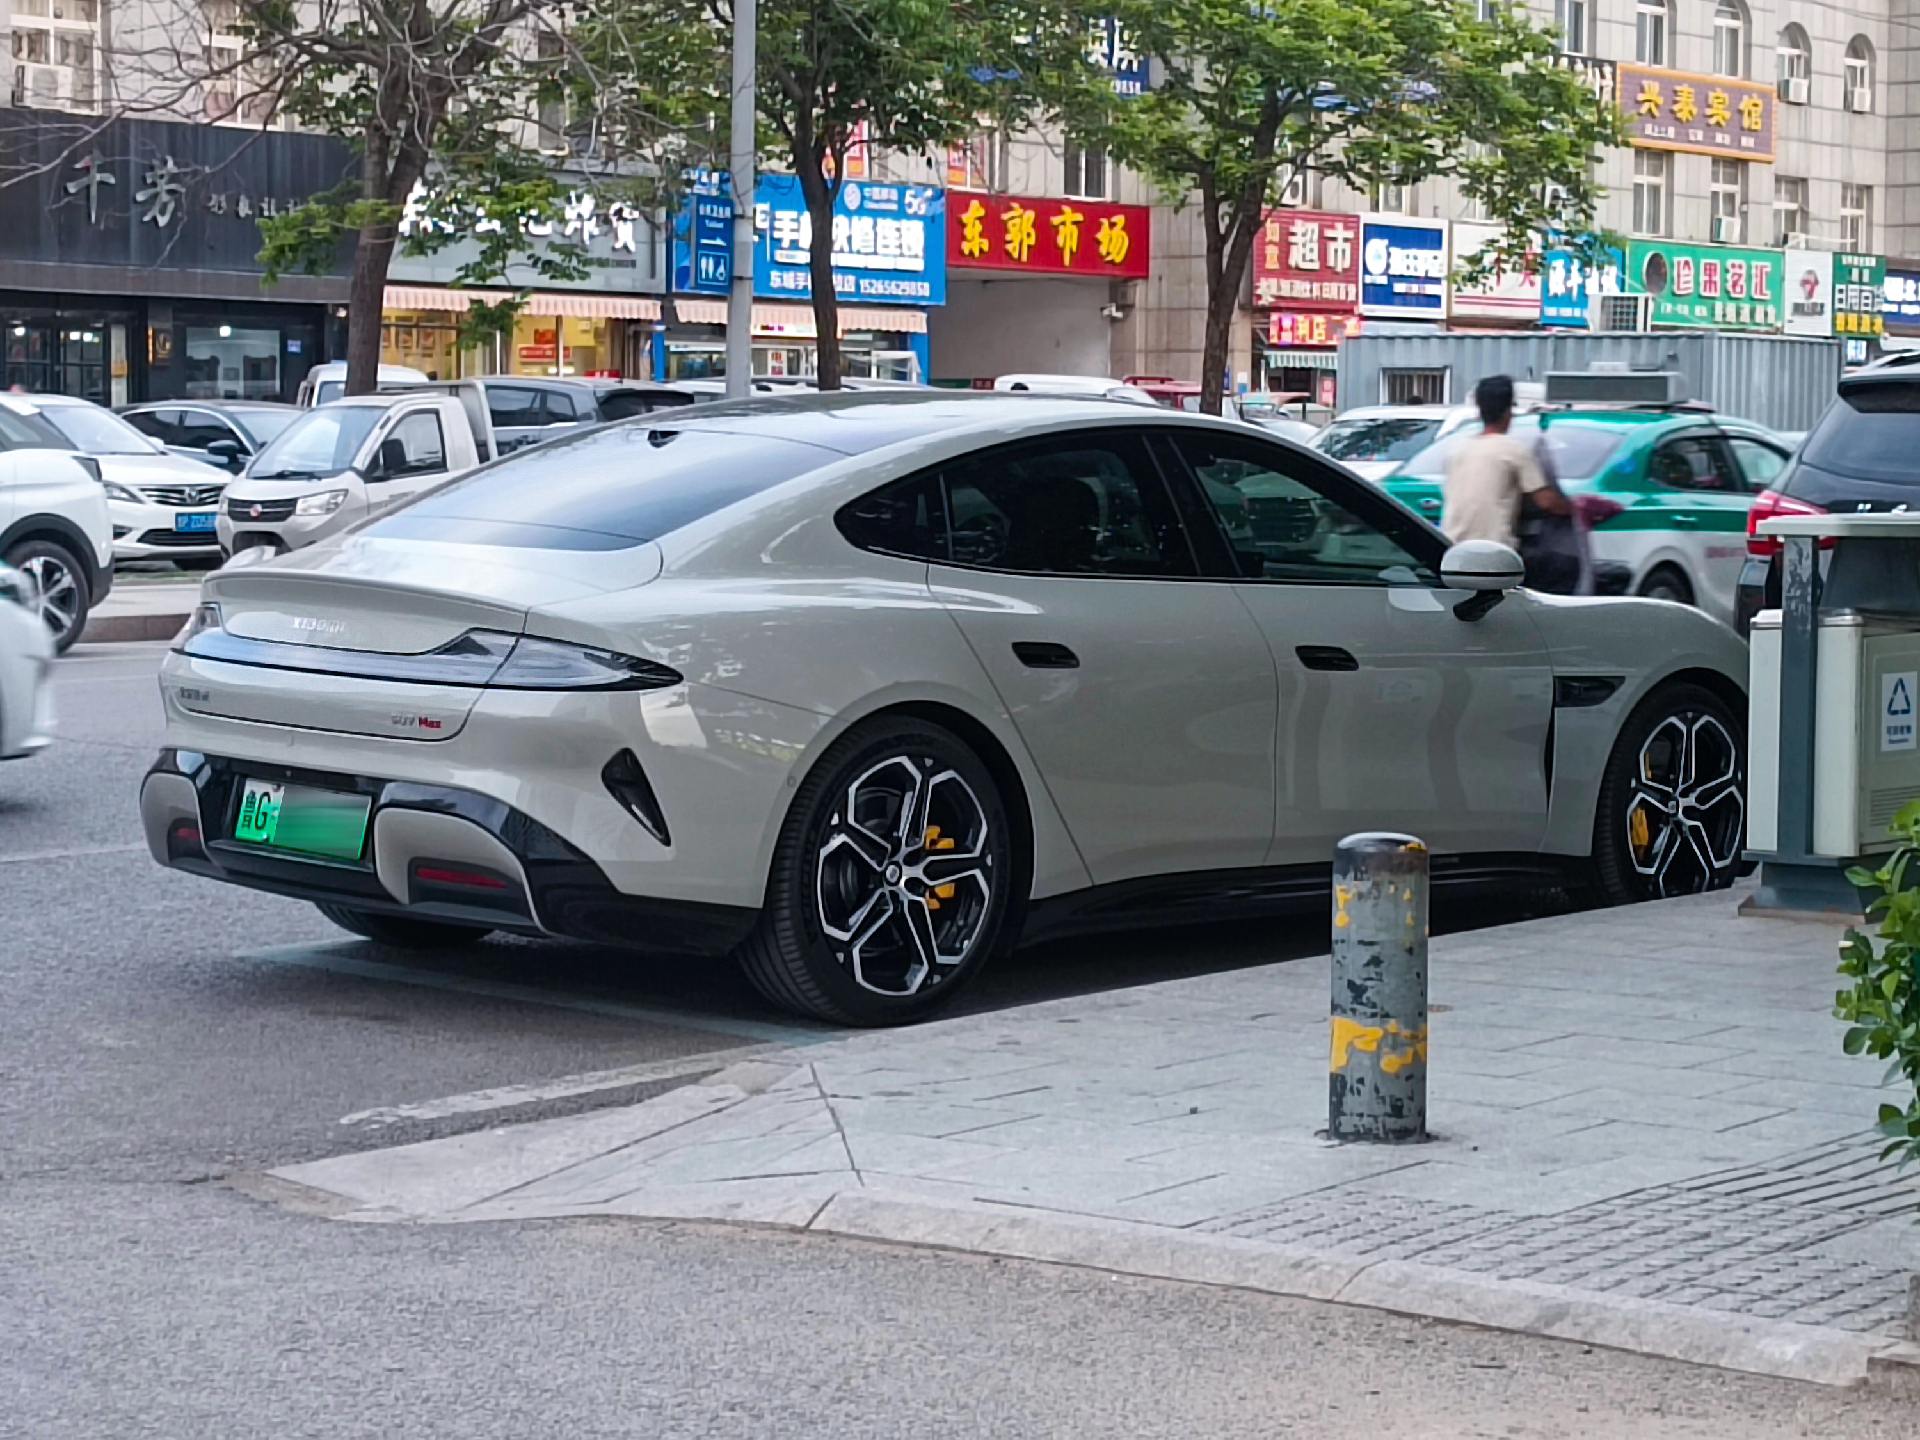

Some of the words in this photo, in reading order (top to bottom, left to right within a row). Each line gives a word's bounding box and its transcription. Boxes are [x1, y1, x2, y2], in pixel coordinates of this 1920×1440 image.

[959, 199, 1130, 267] 东郭市场
[1288, 218, 1355, 273] 超市
